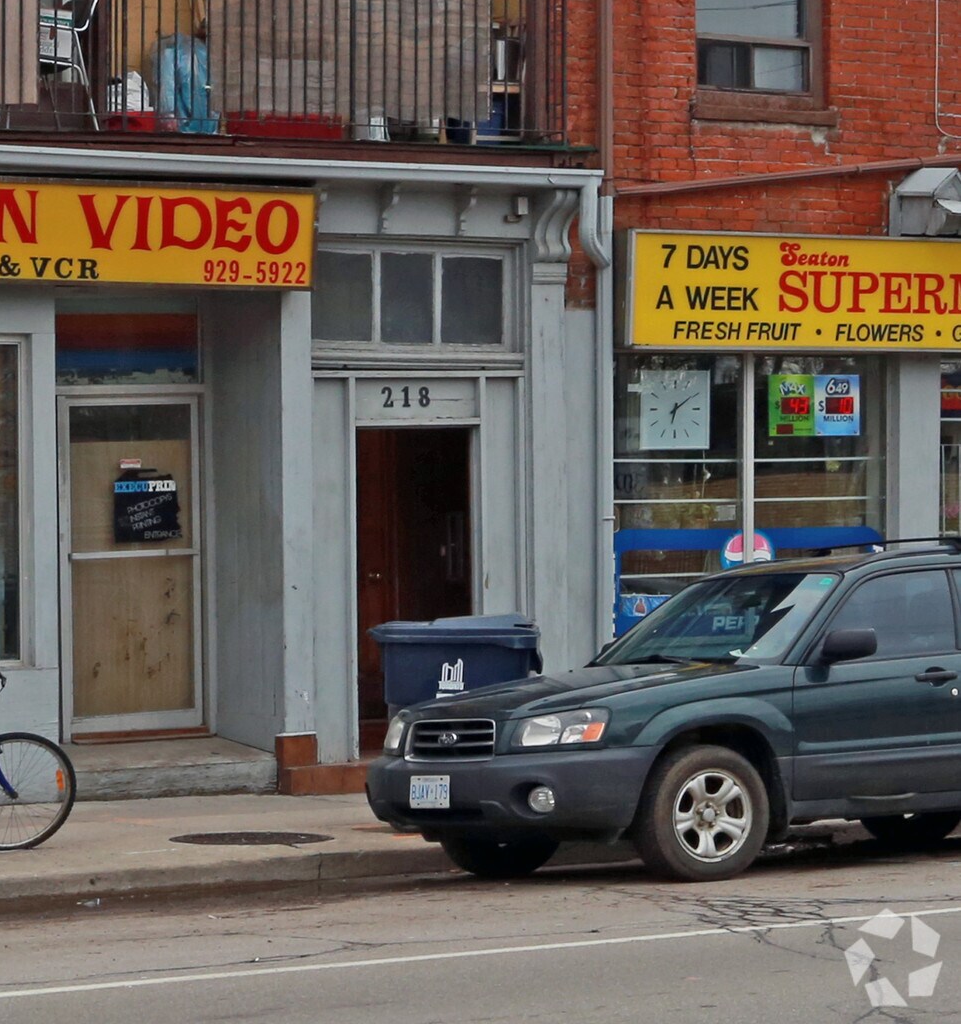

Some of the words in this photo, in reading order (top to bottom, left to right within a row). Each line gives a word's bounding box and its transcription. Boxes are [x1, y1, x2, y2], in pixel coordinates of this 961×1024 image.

[77, 193, 300, 255] VIDEO
[661, 244, 677, 269] 7
[686, 245, 750, 271] DAYS
[779, 241, 850, 268] Seaton
[30, 257, 100, 279] VCR
[203, 259, 306, 284] 929-5922
[655, 285, 675, 310] A
[685, 286, 760, 311] WEEK
[673, 321, 742, 340] FRESH
[746, 322, 802, 341] FRUIT
[835, 324, 924, 342] FLOWERS
[381, 386, 431, 408] 218
[780, 380, 806, 396] MAX
[823, 415, 854, 423] MILLION
